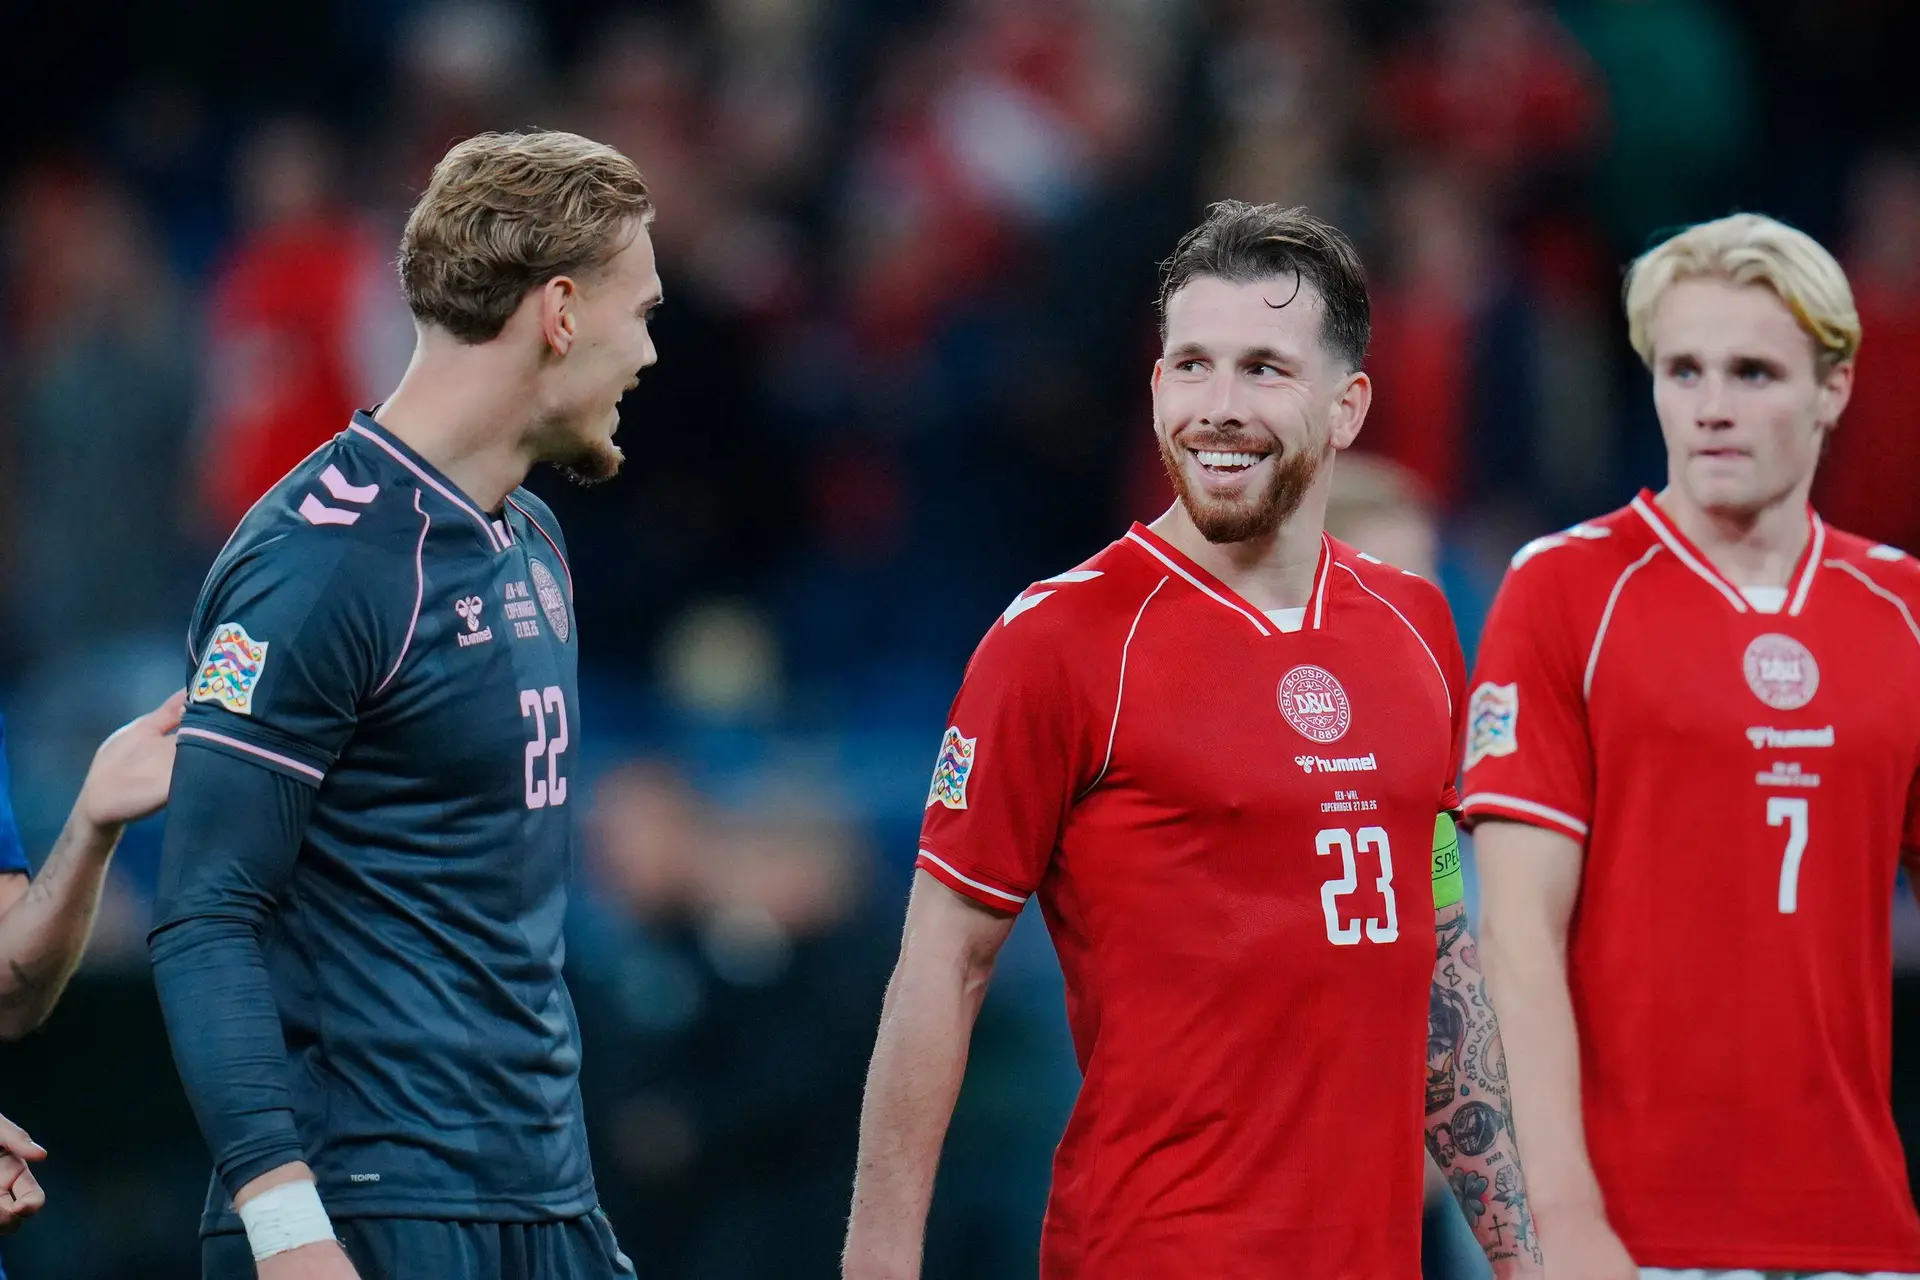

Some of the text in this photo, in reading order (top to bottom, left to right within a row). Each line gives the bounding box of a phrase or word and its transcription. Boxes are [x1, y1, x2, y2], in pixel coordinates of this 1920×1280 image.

[457, 625, 493, 647] hummel
[1282, 689, 1309, 731] DANSK
[1333, 688, 1348, 729] UNION
[1294, 692, 1336, 714] DBU
[1312, 728, 1338, 739] 1889
[520, 685, 568, 809] 22
[1315, 752, 1378, 773] hummel
[1321, 800, 1377, 812] COPENHAGEN 27.09.26
[1766, 796, 1808, 914] 7
[1315, 826, 1399, 945] 23
